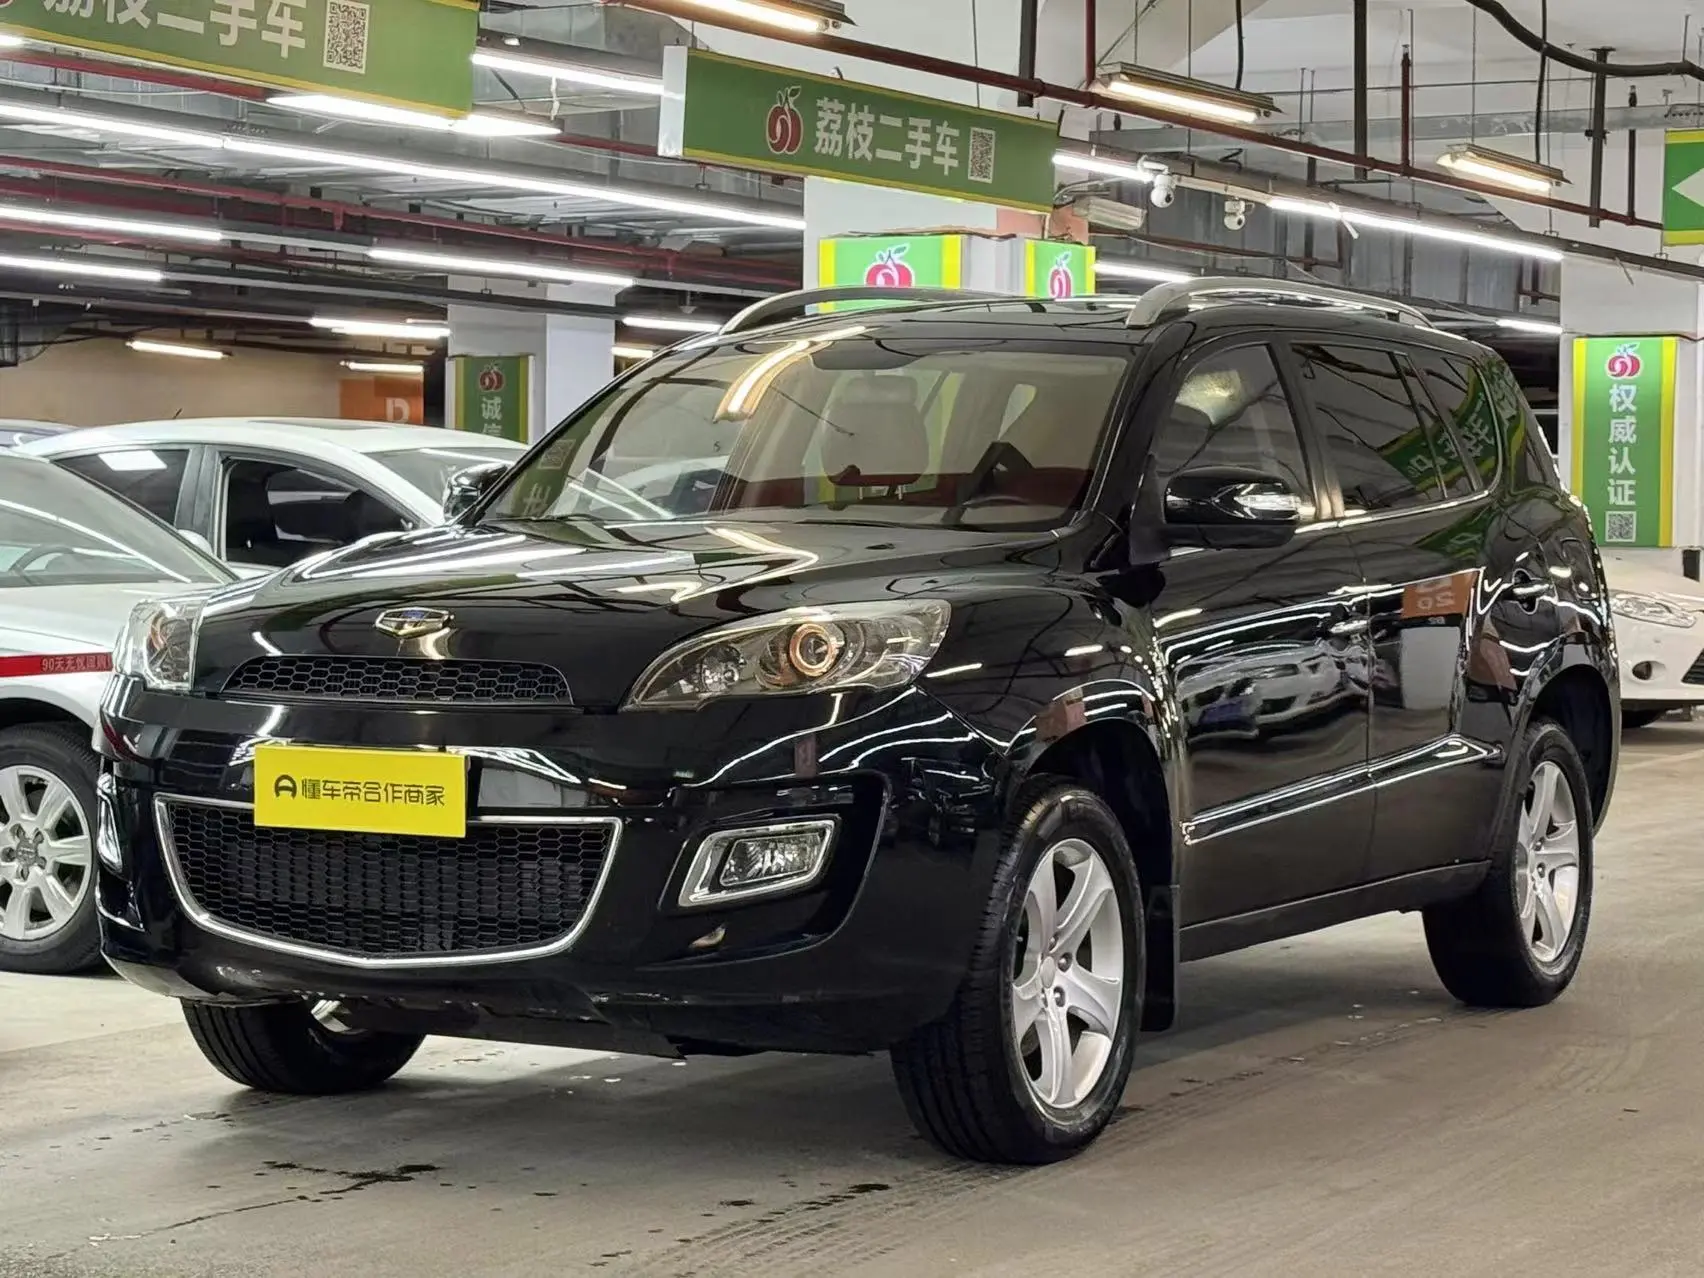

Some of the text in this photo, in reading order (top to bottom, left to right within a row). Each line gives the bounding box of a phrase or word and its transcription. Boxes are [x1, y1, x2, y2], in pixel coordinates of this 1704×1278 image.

[814, 96, 960, 176] 荔枝二手车
[386, 397, 410, 423] D
[1607, 383, 1637, 506] 权威认证
[301, 778, 446, 807] 懂车帝合作商家
